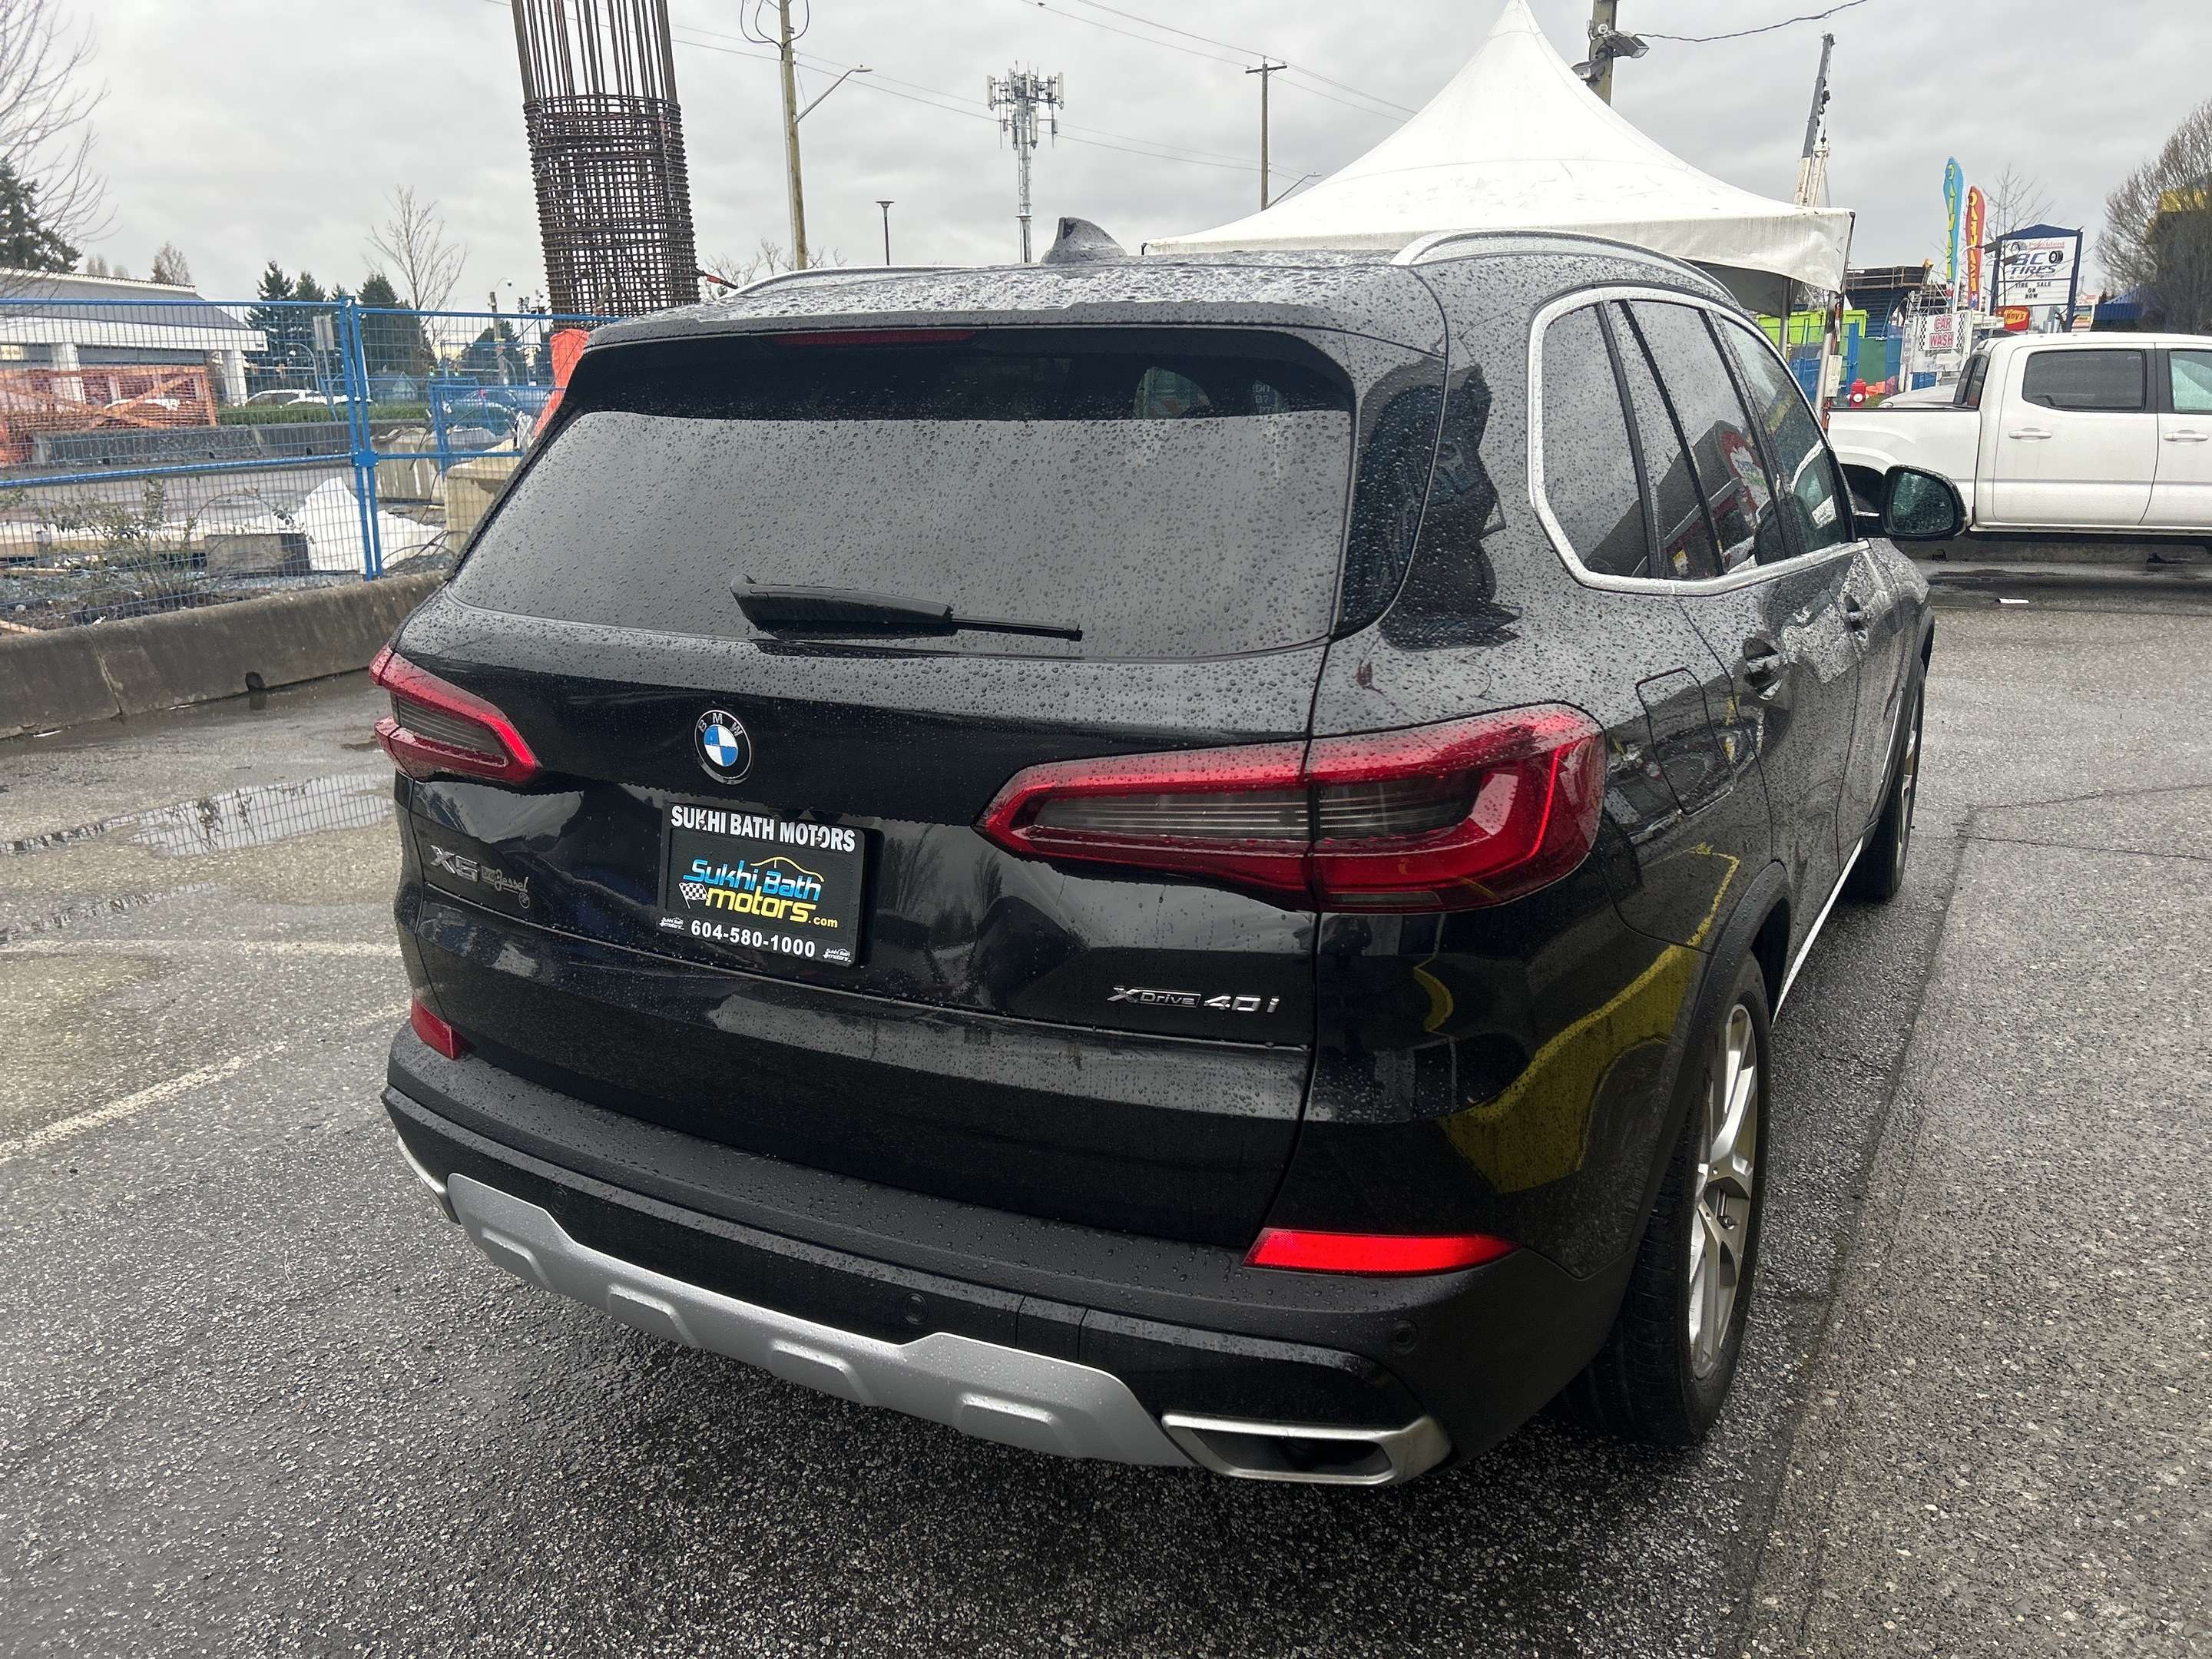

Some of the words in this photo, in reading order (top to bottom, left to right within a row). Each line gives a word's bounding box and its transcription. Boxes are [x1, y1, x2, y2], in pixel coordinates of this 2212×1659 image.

[2010, 265, 2057, 275] TIRES
[1934, 314, 1952, 332] CAR
[1929, 331, 1954, 349] WASH
[697, 711, 743, 737] BMW
[671, 805, 727, 834] SUKHI
[730, 813, 775, 841] BATH
[780, 821, 856, 853] MOTORS
[430, 845, 478, 882] X5
[683, 859, 759, 891] Sukhi
[763, 869, 823, 902] Bath
[690, 920, 816, 958] 604-580-1000
